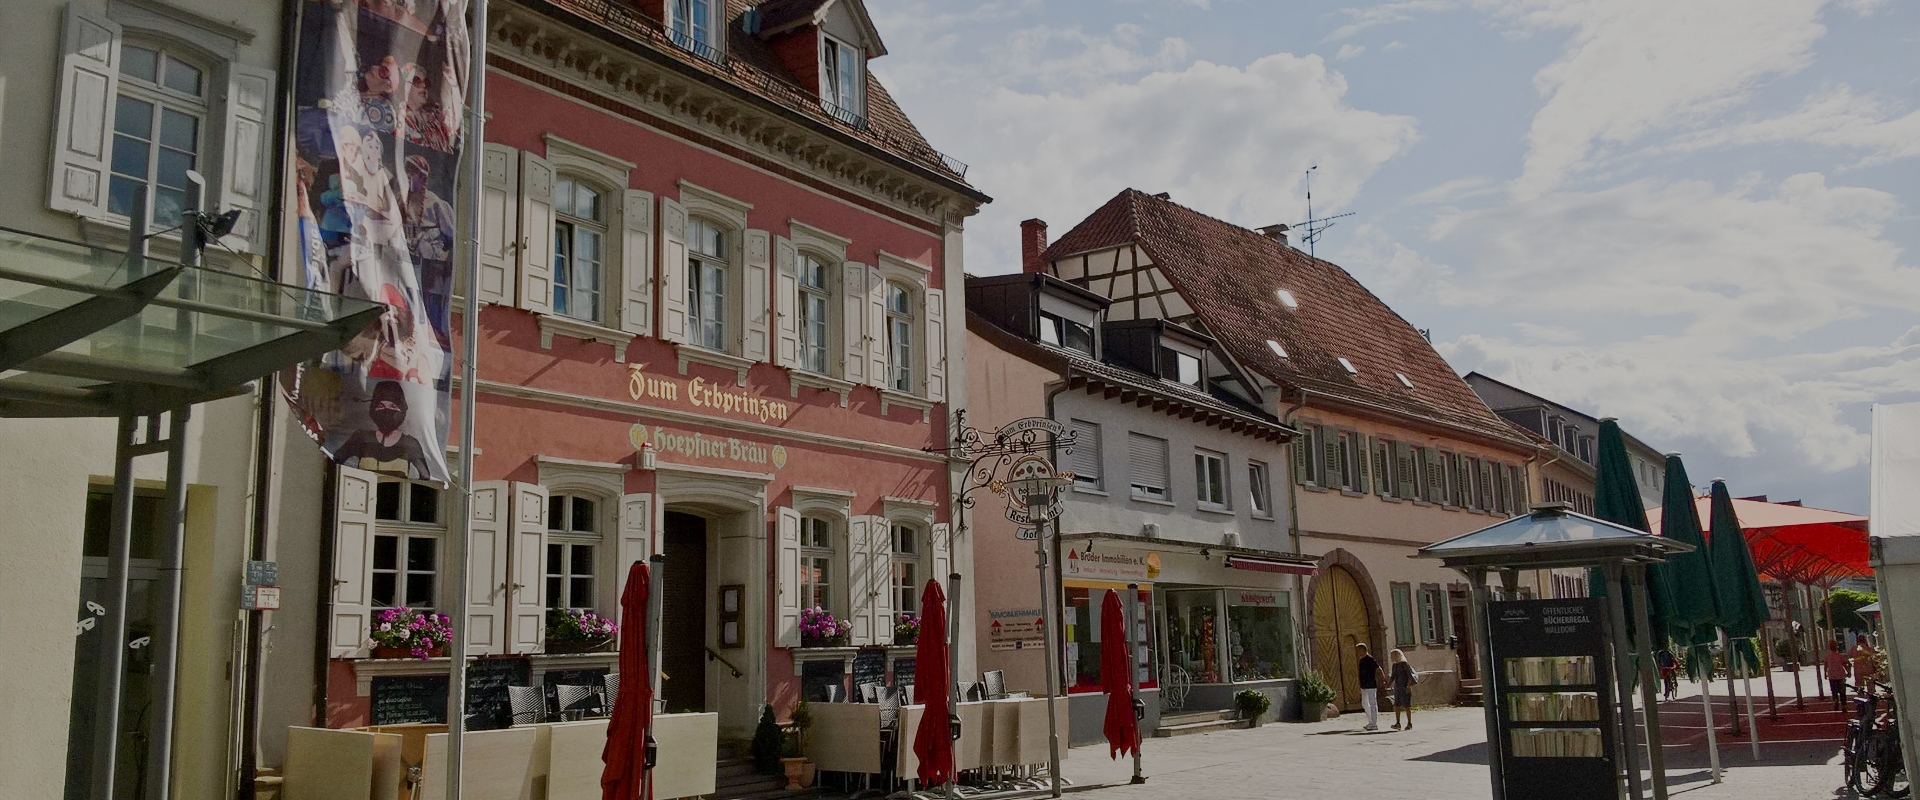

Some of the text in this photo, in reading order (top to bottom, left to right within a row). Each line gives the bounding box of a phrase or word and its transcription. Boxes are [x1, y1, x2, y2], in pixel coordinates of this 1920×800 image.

[628, 362, 788, 424] Zum Erbprinzen
[653, 425, 767, 464] Hoepfner Bräu
[1009, 506, 1058, 524] Restnt
[1101, 553, 1133, 565] Immobilien
[990, 609, 1042, 619] IMMOBILIENMAKLE
[1542, 606, 1584, 615] ÖFFENTLICHES
[1543, 615, 1590, 624] BÜCHERREGAL
[1544, 625, 1577, 634] WALLDORF
